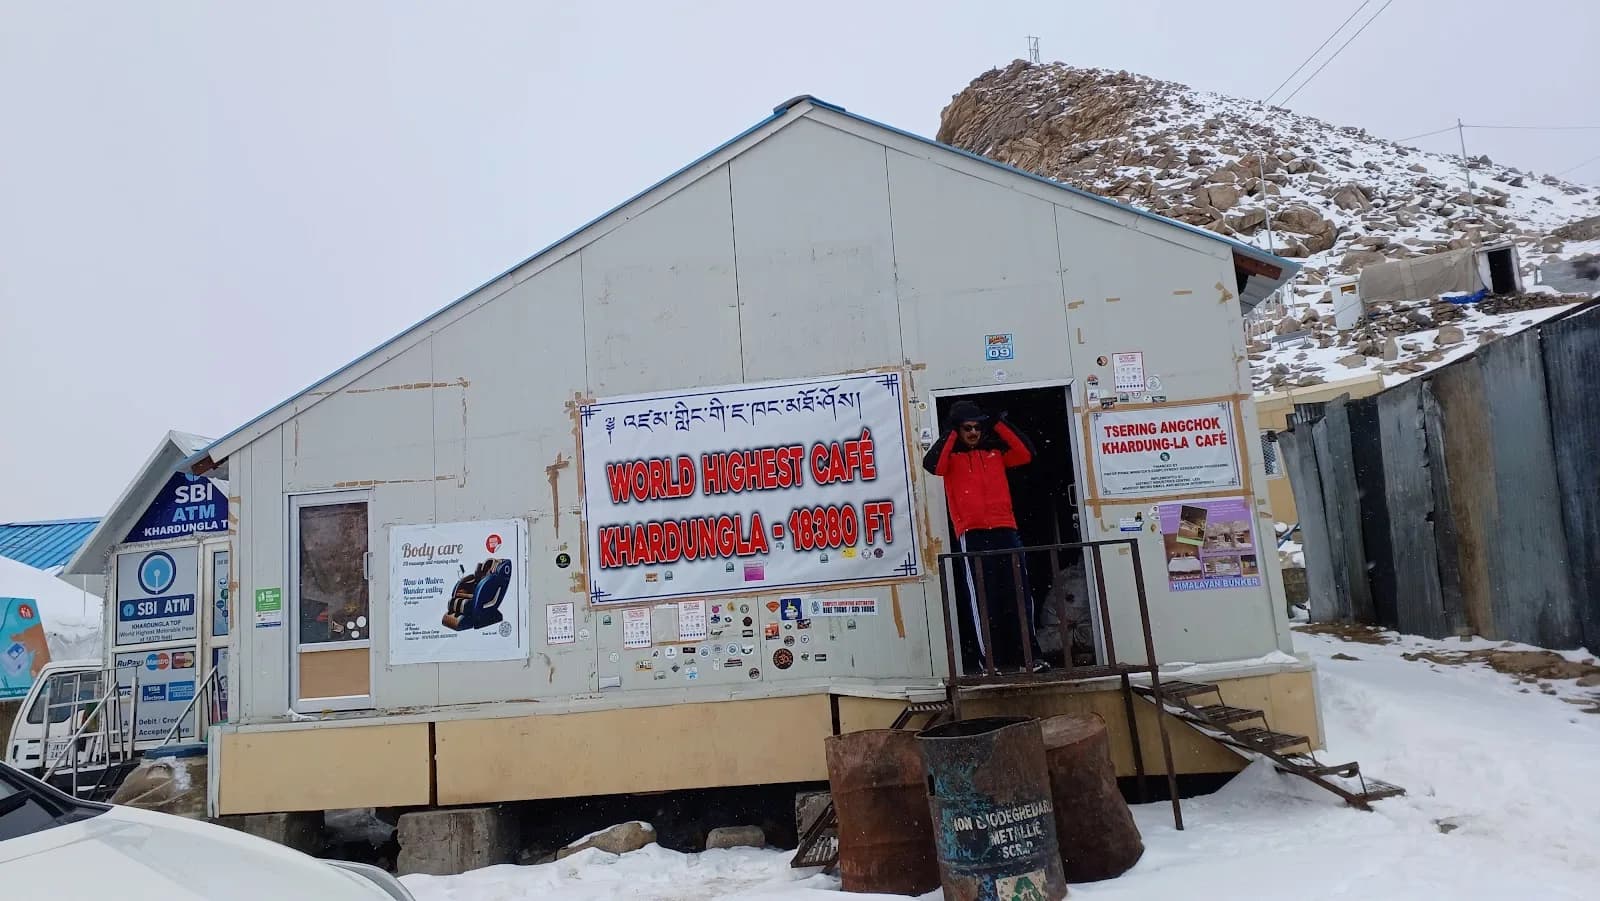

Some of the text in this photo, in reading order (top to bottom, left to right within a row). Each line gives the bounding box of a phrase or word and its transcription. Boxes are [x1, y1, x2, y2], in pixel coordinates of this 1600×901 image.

[1104, 417, 1221, 438] TSERING ANGCHOK
[1102, 432, 1227, 455] KHARDUNG-LA CAFÉ
[607, 428, 876, 503] WORLD HIGHEST CAFÉ
[174, 483, 213, 504] SBI
[172, 504, 215, 522] ATM
[144, 521, 218, 537] KHARDUNGLA
[600, 513, 768, 568] KHARDUNGLA
[788, 505, 857, 551] 18380
[863, 501, 894, 545] FT
[402, 542, 464, 560] Body care
[1173, 578, 1258, 590] HIMALAYAN BUNKER
[137, 599, 190, 617] SBI ATM
